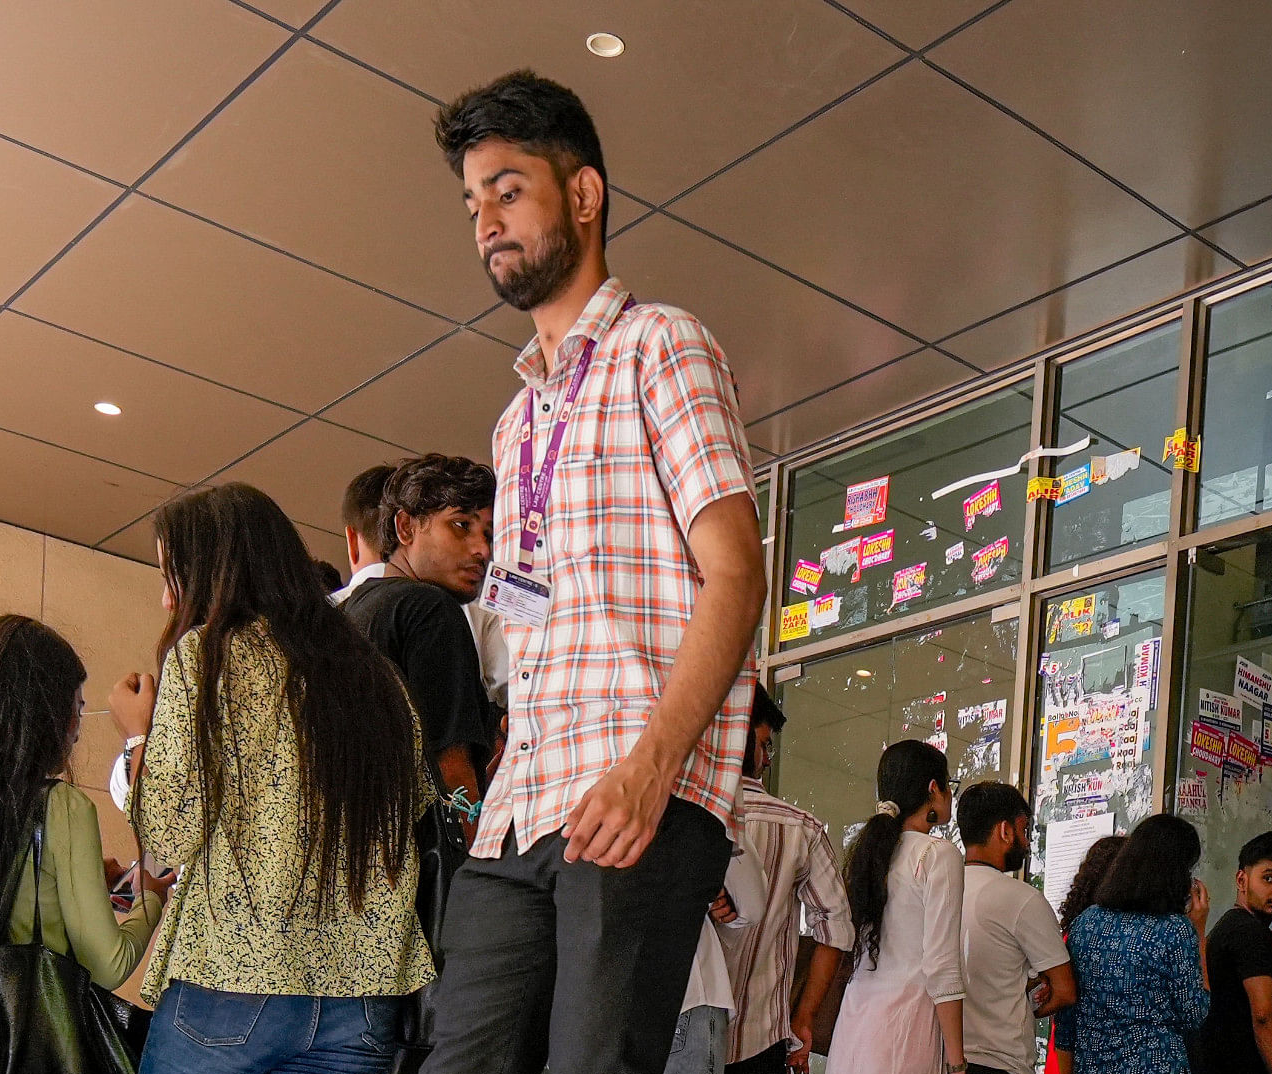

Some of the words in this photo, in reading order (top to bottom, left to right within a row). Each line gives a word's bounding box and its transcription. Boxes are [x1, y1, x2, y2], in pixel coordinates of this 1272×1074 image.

[967, 488, 998, 516] LOKESHH
[863, 536, 893, 557] LOKESHH
[782, 620, 808, 631] ZAFA
[783, 612, 808, 625] MALI
[1140, 643, 1151, 679] KUMAR
[1238, 667, 1272, 691] HIMANSHU
[1238, 679, 1269, 702] NAAGAR
[1200, 699, 1220, 714] NITISH
[1220, 704, 1241, 720] KUMAR
[1194, 731, 1223, 755] LOKESHH
[1264, 727, 1270, 739] 5
[1192, 746, 1222, 766] CHOUDHARY
[1229, 742, 1257, 766] LOKESHH
